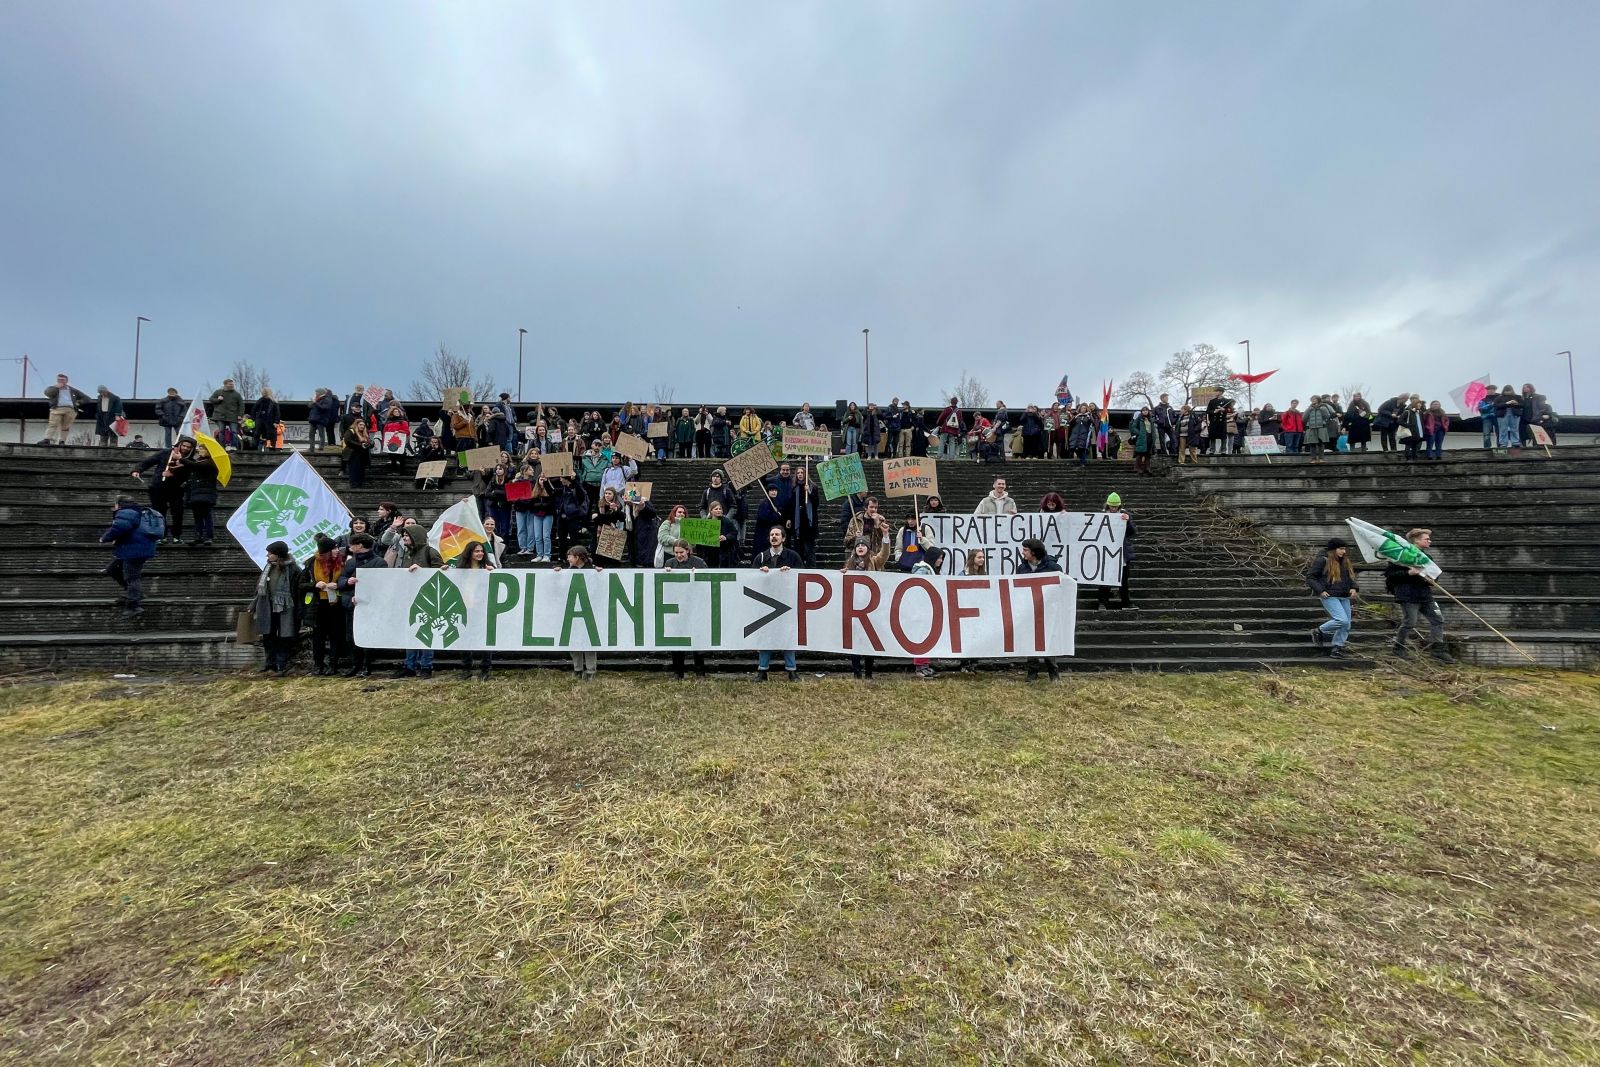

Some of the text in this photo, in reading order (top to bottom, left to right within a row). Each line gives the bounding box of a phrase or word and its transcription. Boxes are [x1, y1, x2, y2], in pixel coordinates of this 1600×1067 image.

[734, 460, 773, 487] NARAVO
[887, 461, 901, 470] ZA
[1078, 513, 1115, 542] ZA
[486, 573, 736, 646] PLANET
[798, 573, 1060, 655] PROFIT
